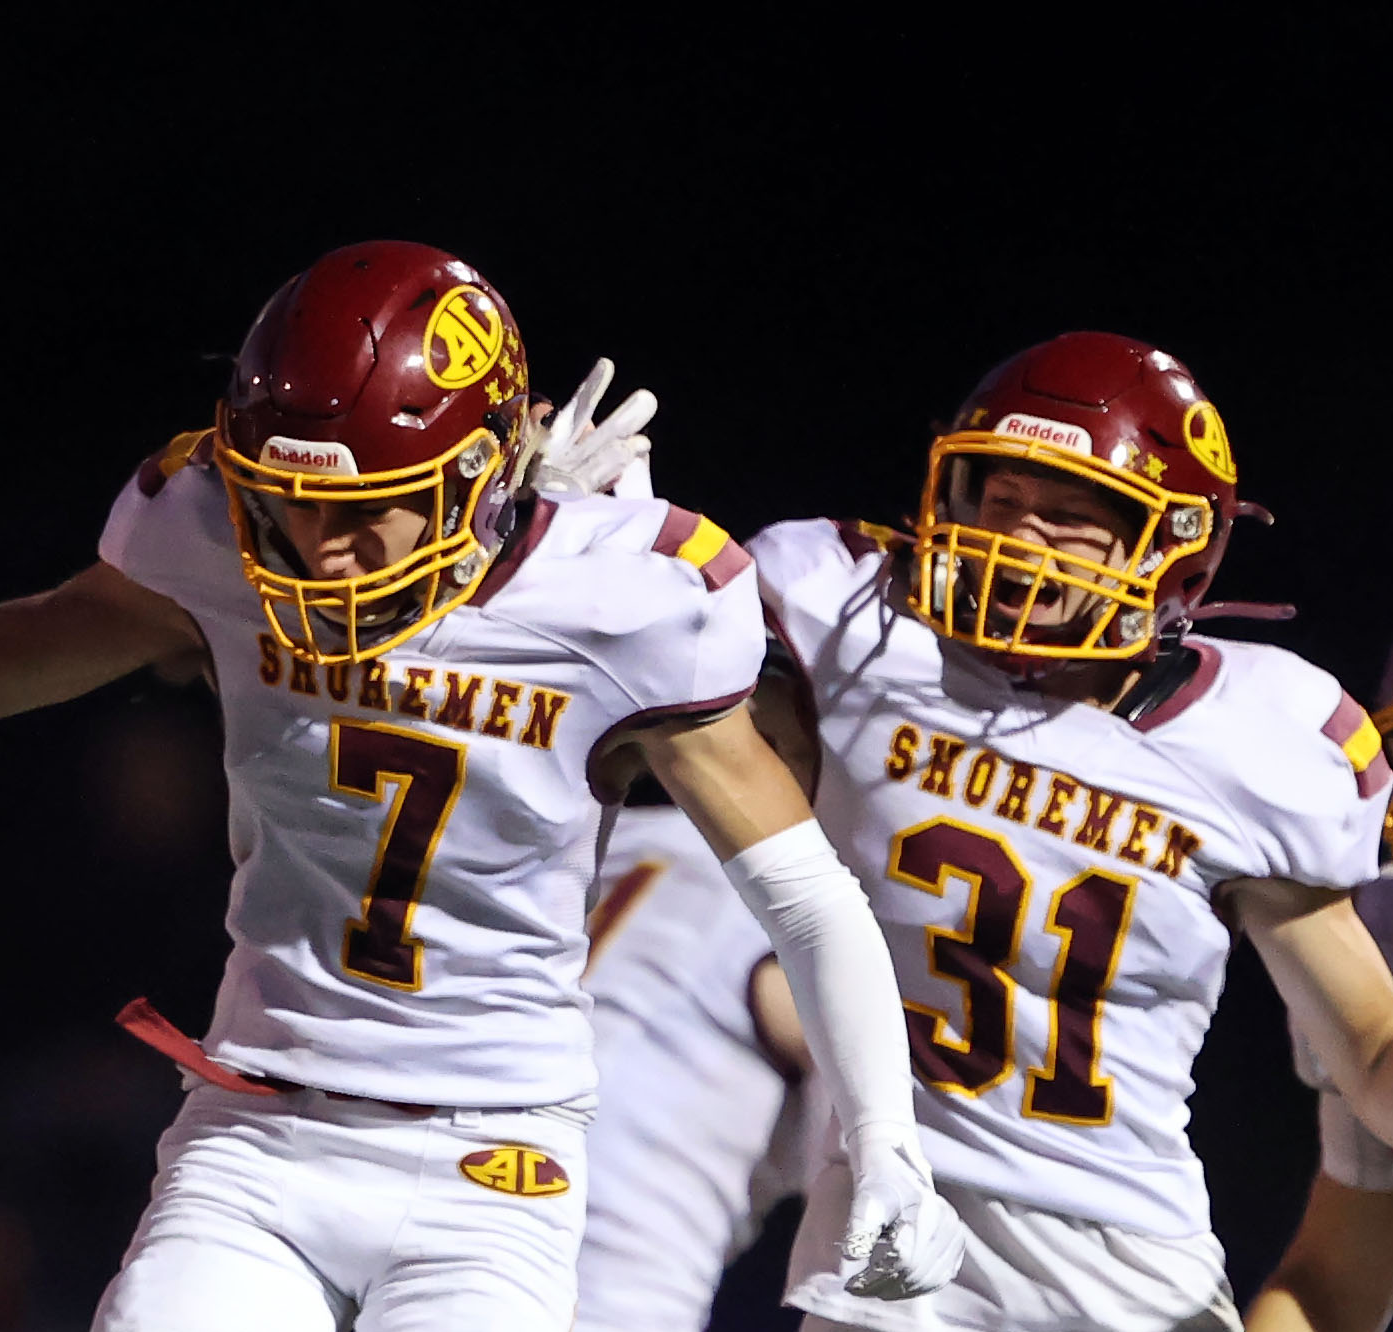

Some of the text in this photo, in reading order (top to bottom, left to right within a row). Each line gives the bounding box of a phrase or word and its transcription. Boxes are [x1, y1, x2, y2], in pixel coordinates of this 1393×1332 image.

[269, 444, 339, 468] Riddell
[1006, 418, 1080, 447] Riddell
[884, 722, 1205, 880] SHOREMEN
[328, 715, 468, 992] 7
[886, 814, 1140, 1128] 31
[459, 1146, 572, 1197] AL
